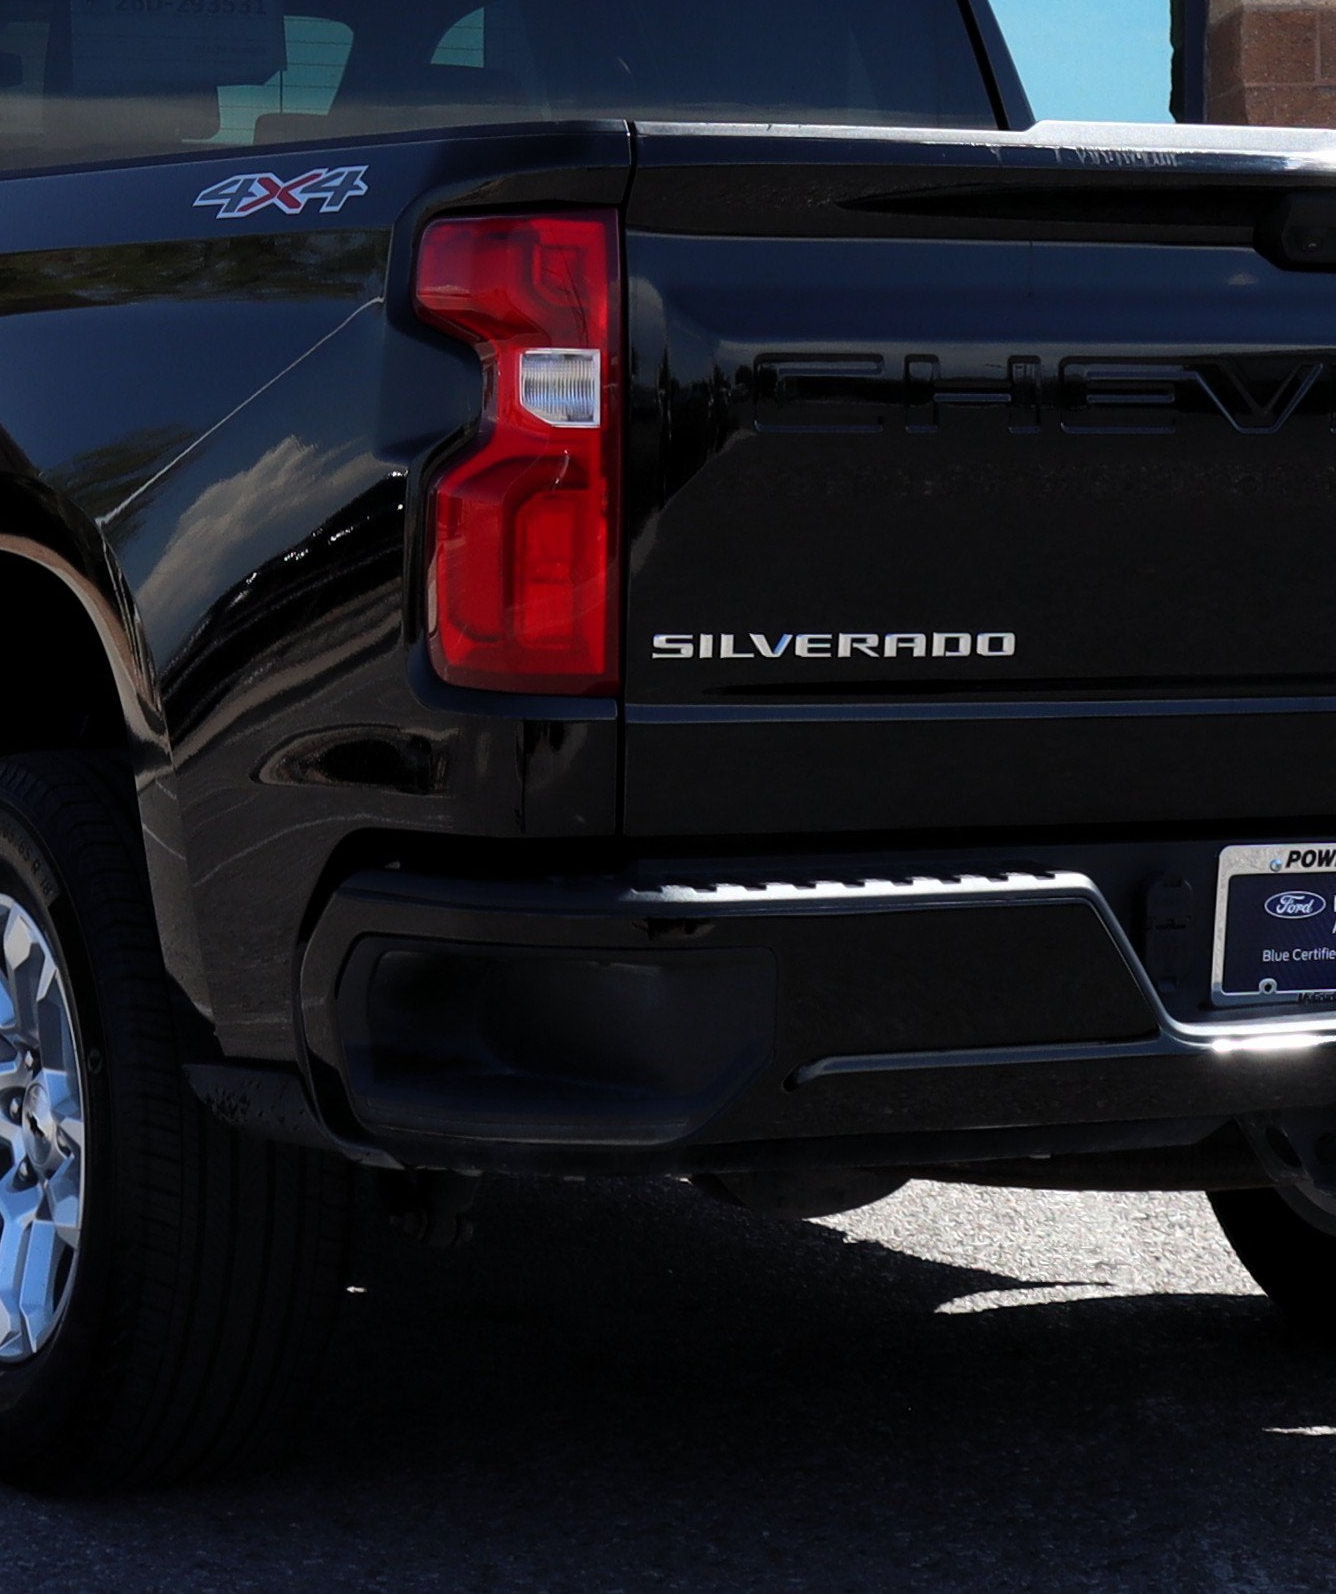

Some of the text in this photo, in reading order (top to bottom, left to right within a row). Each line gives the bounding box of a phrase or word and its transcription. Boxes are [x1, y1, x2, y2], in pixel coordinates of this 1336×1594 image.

[651, 631, 1017, 660] SILVERADO
[1276, 894, 1314, 914] Ford
[1262, 949, 1289, 962] Blue
